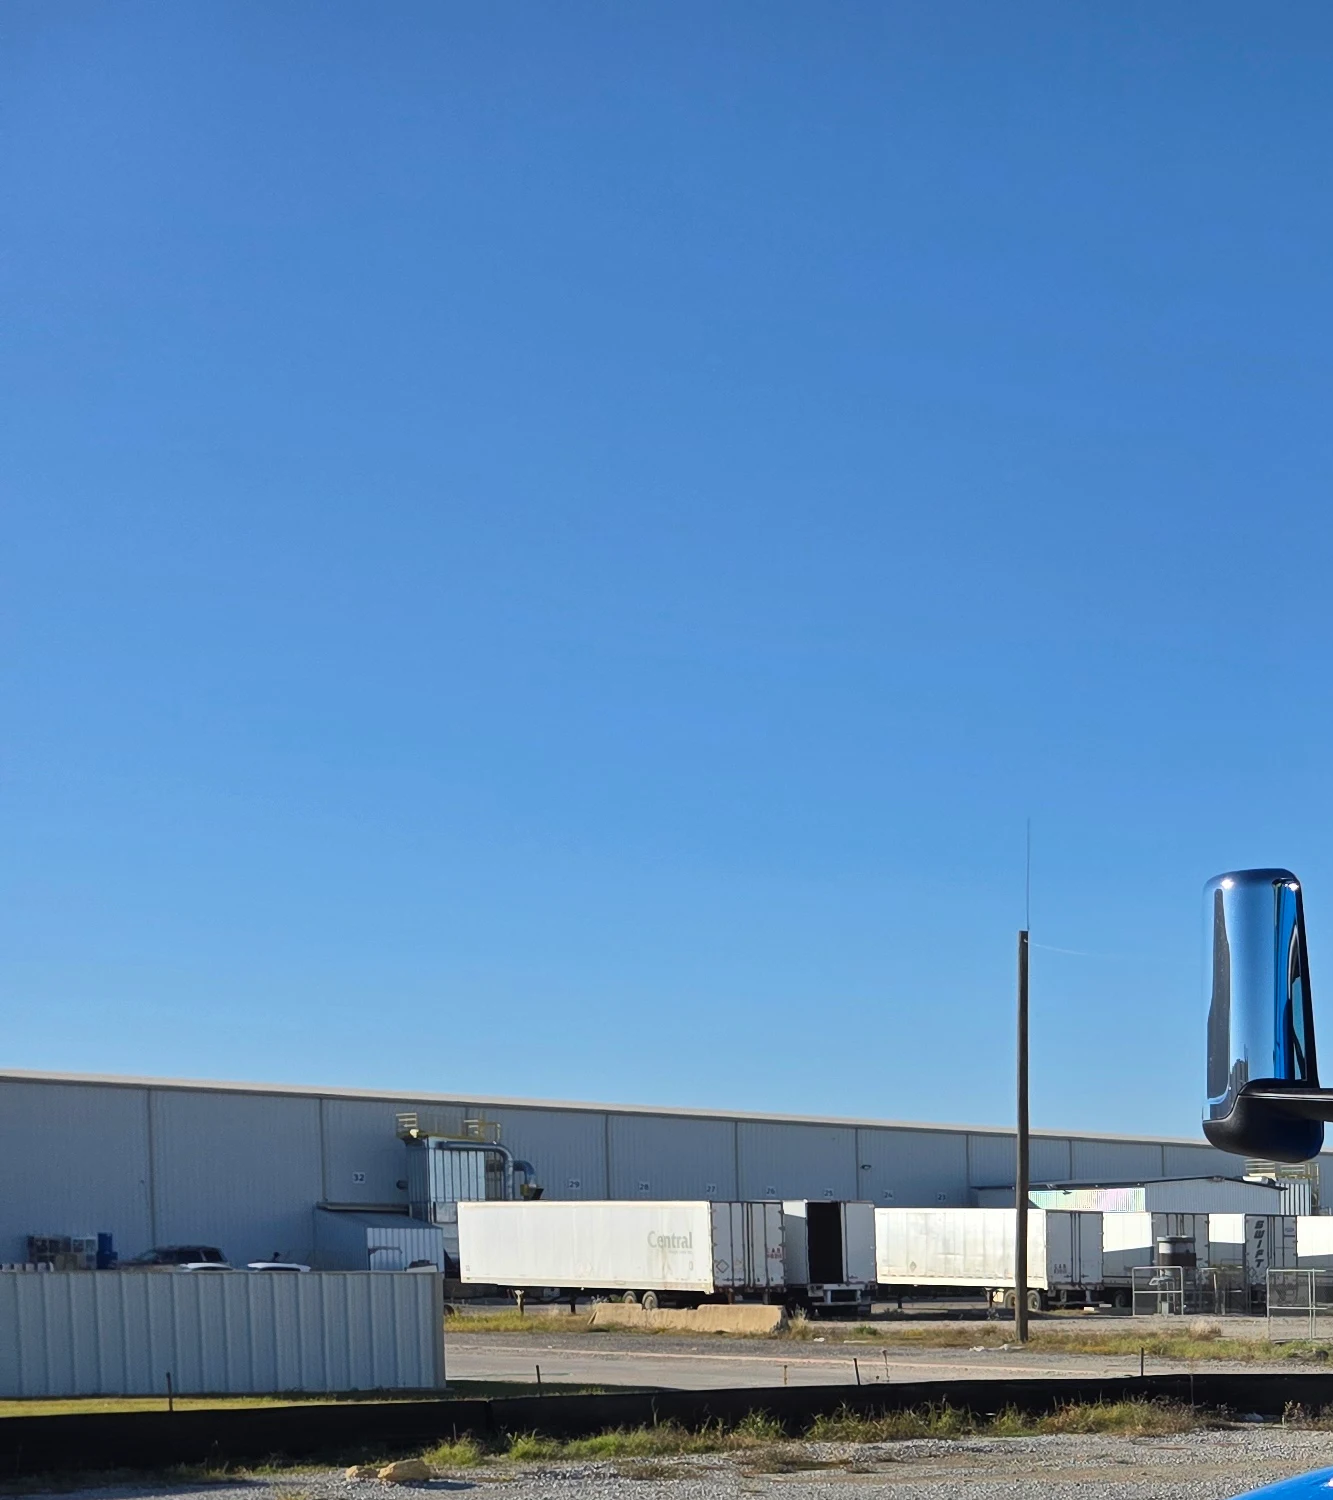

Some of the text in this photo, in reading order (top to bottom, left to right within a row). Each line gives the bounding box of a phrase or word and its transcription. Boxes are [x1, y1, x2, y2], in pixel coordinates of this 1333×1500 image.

[353, 1173, 365, 1182] 32
[569, 1180, 580, 1188] 29
[647, 1231, 693, 1249] Central
[1253, 1220, 1265, 1268] SWIFT
